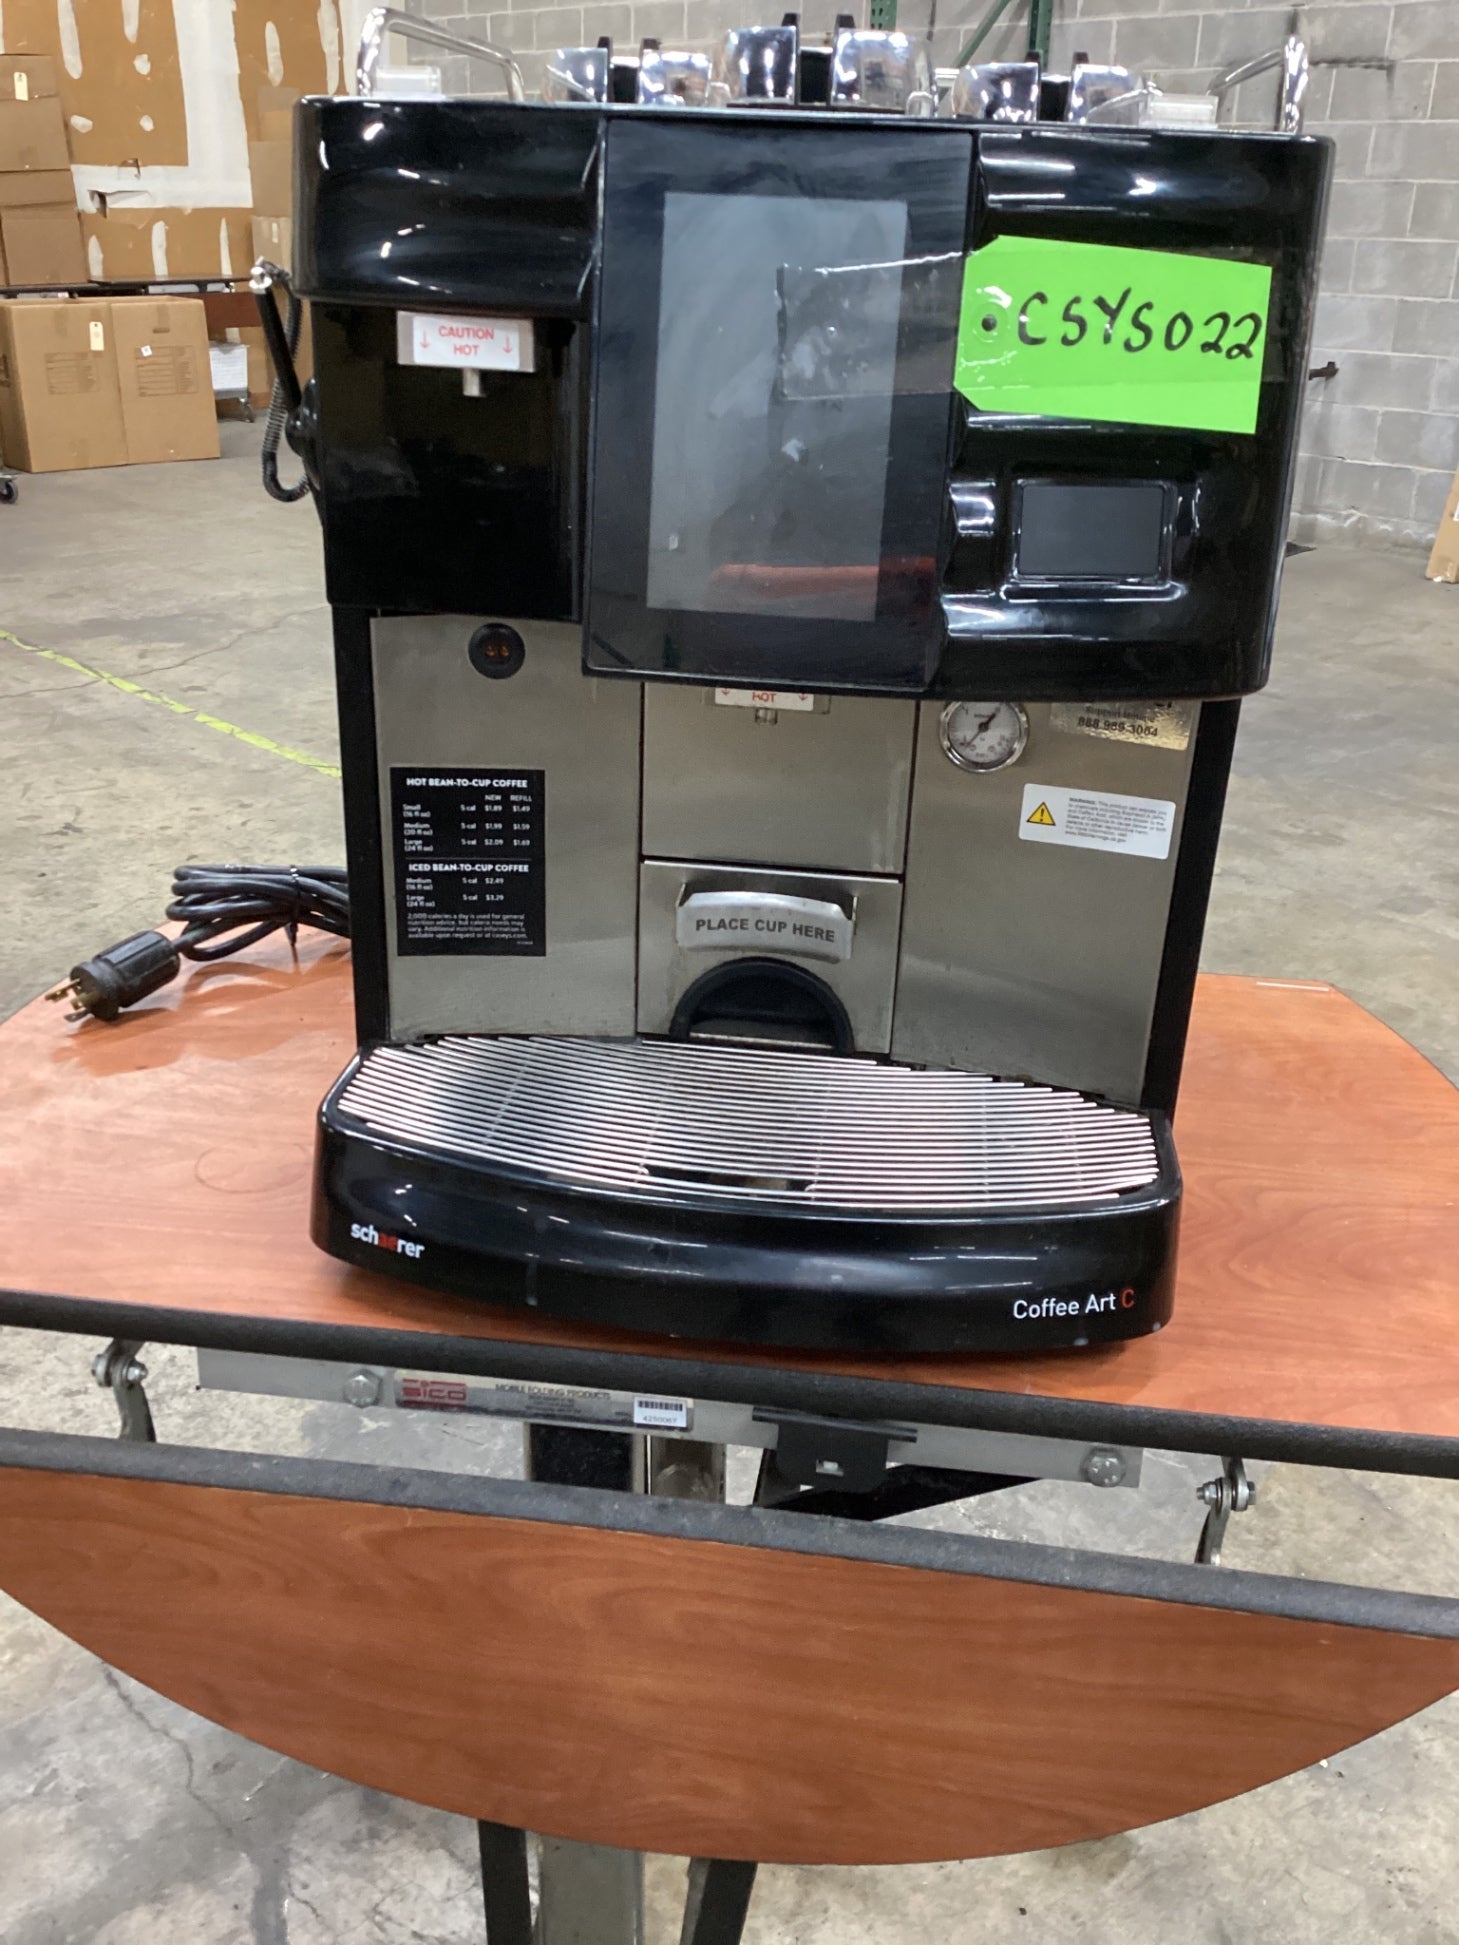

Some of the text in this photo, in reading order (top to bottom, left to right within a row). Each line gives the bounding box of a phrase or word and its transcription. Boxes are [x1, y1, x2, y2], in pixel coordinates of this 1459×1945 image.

[1018, 287, 1262, 360] CSYS022
[438, 325, 494, 340] CAUTION
[454, 344, 479, 356] HOT
[752, 691, 777, 703] HOT
[406, 778, 528, 788] HOT BEAN-TO-CUP COFFEE
[432, 864, 493, 872] BEAN-TO-CUP
[495, 864, 529, 872] COFFEE
[696, 918, 835, 943] PLACE CUP HERE
[1013, 1288, 1134, 1319] Coffee Art C
